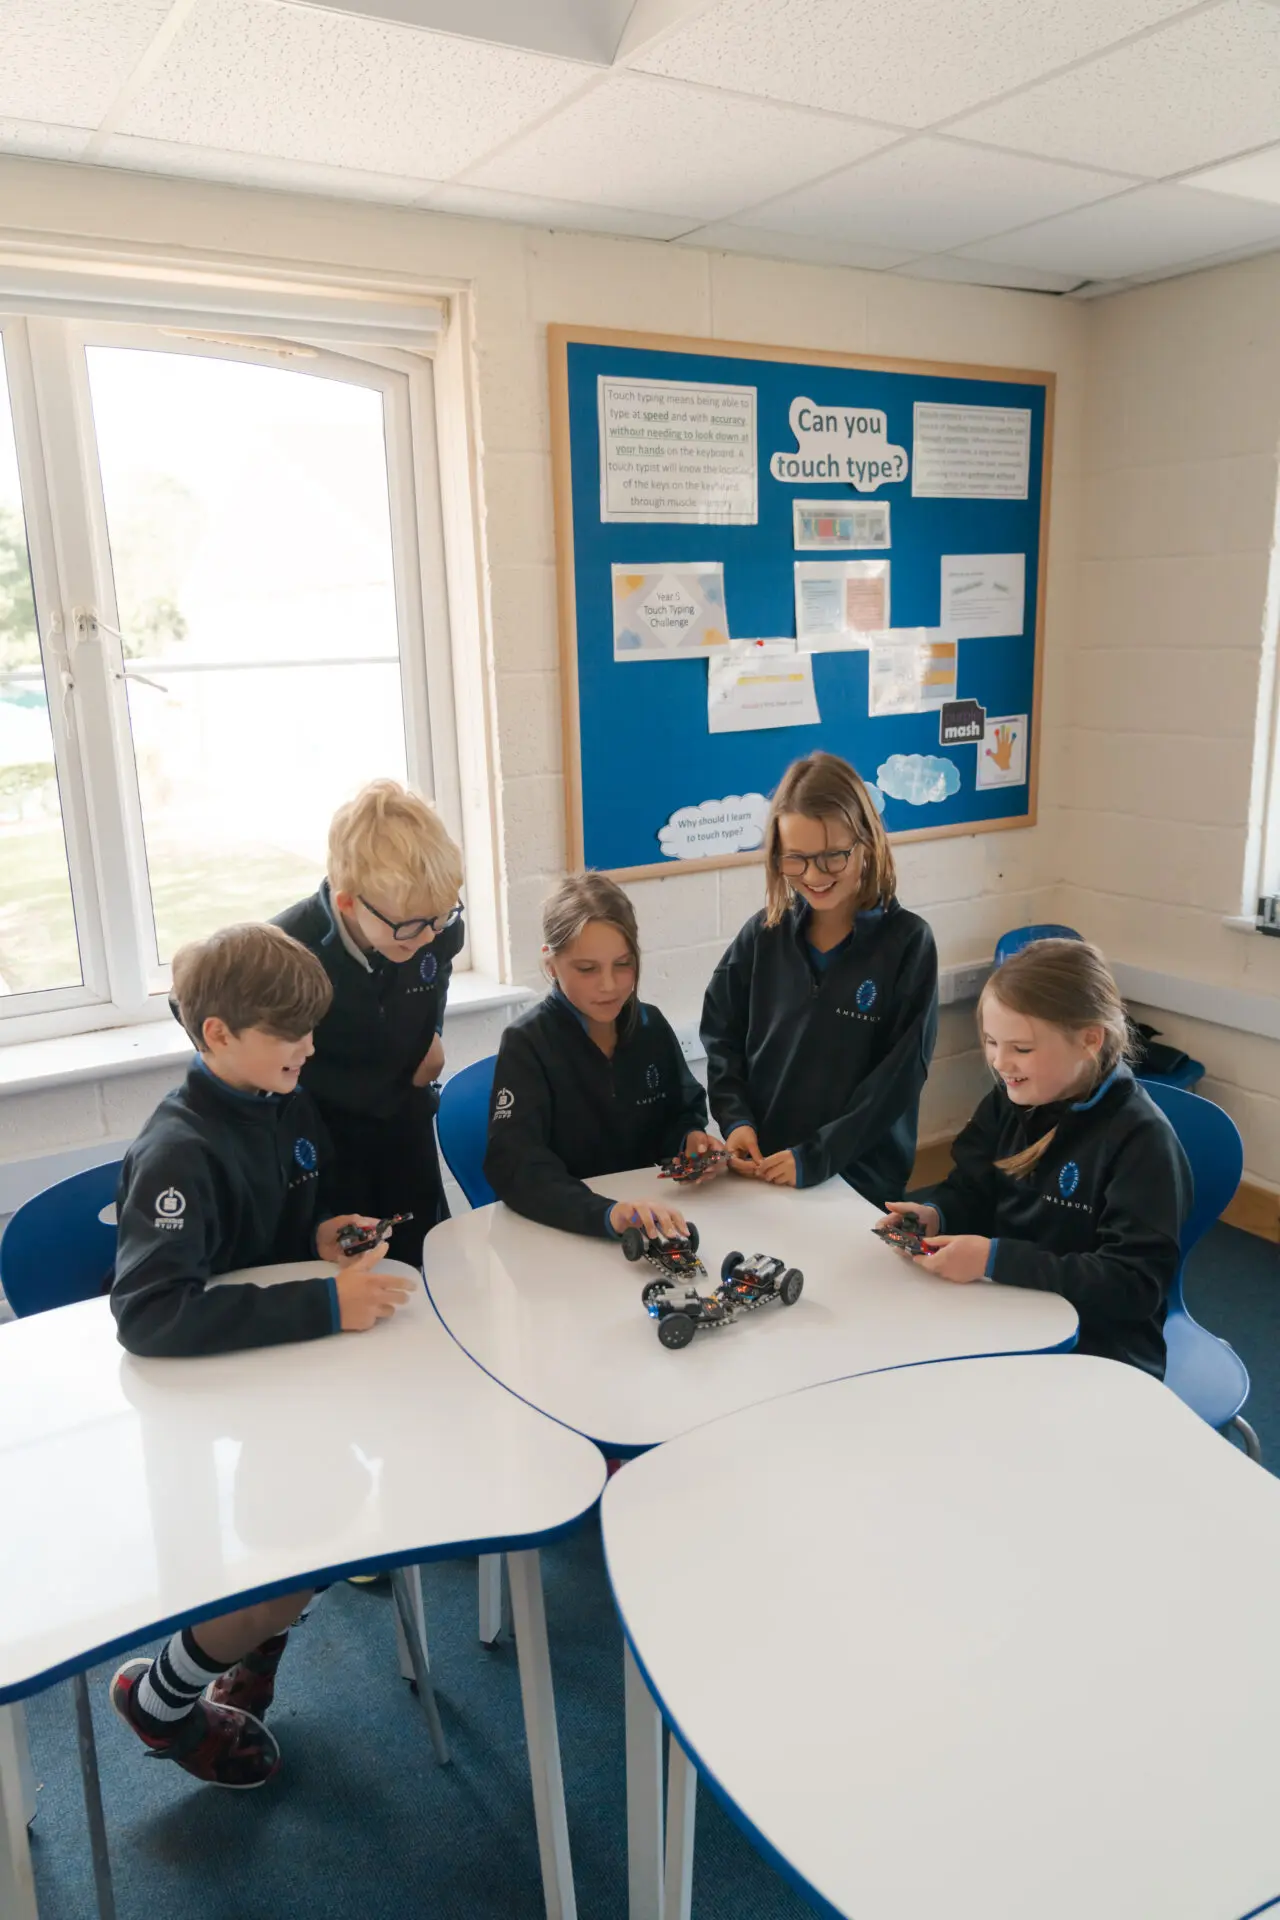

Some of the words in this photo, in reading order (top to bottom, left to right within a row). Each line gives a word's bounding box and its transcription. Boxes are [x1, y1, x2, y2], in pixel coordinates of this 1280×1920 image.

[607, 389, 635, 401] Touch
[637, 392, 665, 405] typing
[667, 395, 695, 405] means
[697, 395, 720, 408] being
[722, 396, 740, 407] able
[740, 400, 750, 408] to
[610, 408, 630, 420] type
[632, 410, 640, 419] at
[643, 411, 669, 421] speed
[671, 412, 687, 422] and
[689, 413, 708, 423] with
[711, 416, 746, 426] accuracy
[798, 408, 838, 432] Can
[844, 416, 881, 439] you
[609, 426, 645, 437] without
[647, 429, 682, 441] needing
[684, 431, 694, 440] to
[695, 430, 713, 440] look
[715, 431, 739, 441] down
[741, 433, 749, 442] at
[615, 445, 636, 456] your
[638, 444, 665, 455] hands
[667, 447, 678, 456] on
[680, 446, 695, 457] the
[608, 461, 634, 472] touch
[636, 463, 660, 475] typist
[662, 462, 678, 473] will
[679, 462, 702, 474] know
[703, 464, 718, 474] the
[777, 453, 840, 477] touch
[846, 455, 903, 483] type?
[622, 478, 633, 489] of
[634, 479, 649, 489] the
[651, 479, 670, 491] keys
[672, 481, 684, 490] on
[685, 480, 700, 490] the
[630, 496, 665, 509] through
[667, 496, 697, 507] muscle
[656, 591, 673, 601] Year
[643, 605, 668, 615] Touch
[668, 604, 695, 616] Typing
[650, 617, 689, 629] Challenge
[945, 720, 980, 739] mash
[677, 819, 697, 829] Why
[698, 814, 725, 825] should
[731, 811, 752, 821] learn
[686, 834, 696, 843] to
[697, 829, 720, 841] touch
[721, 826, 744, 840] type?
